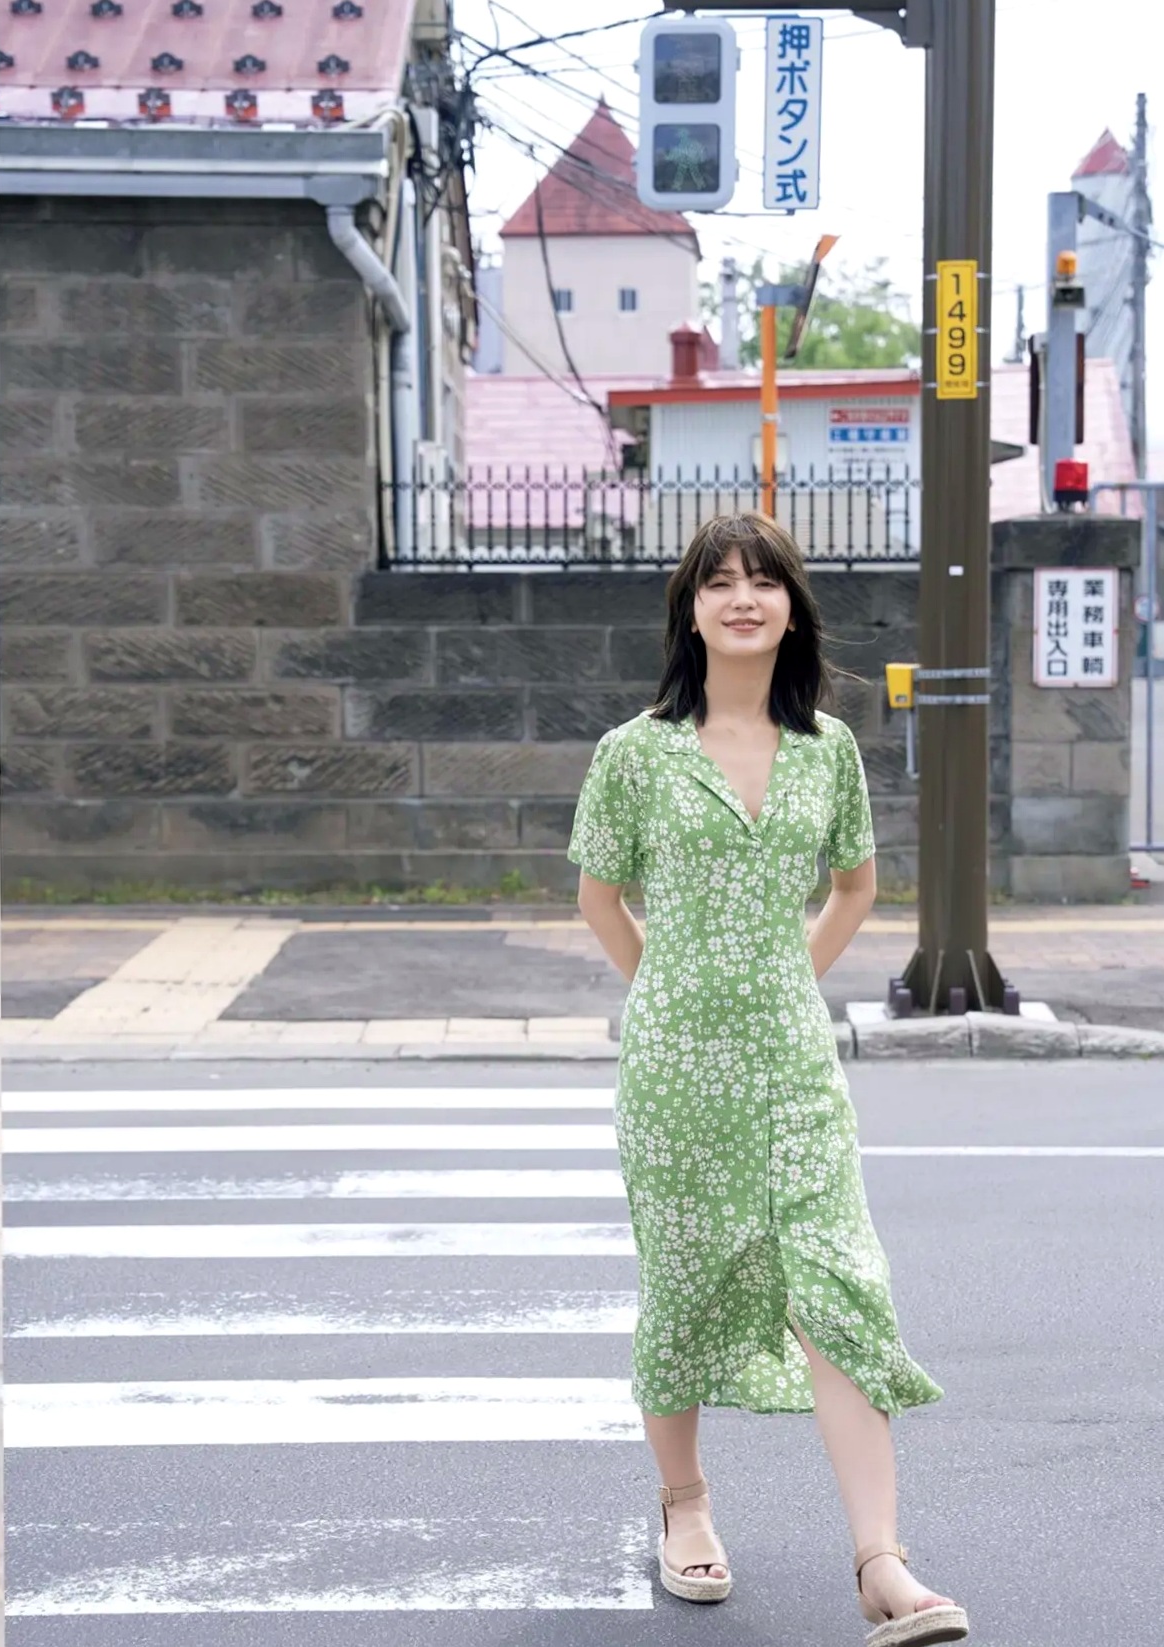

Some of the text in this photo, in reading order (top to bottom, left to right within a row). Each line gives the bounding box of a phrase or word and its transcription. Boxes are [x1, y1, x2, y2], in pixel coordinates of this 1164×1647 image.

[776, 24, 811, 203] 押ボタン式
[948, 273, 966, 376] 1499
[1047, 580, 1068, 676] 専用出入口
